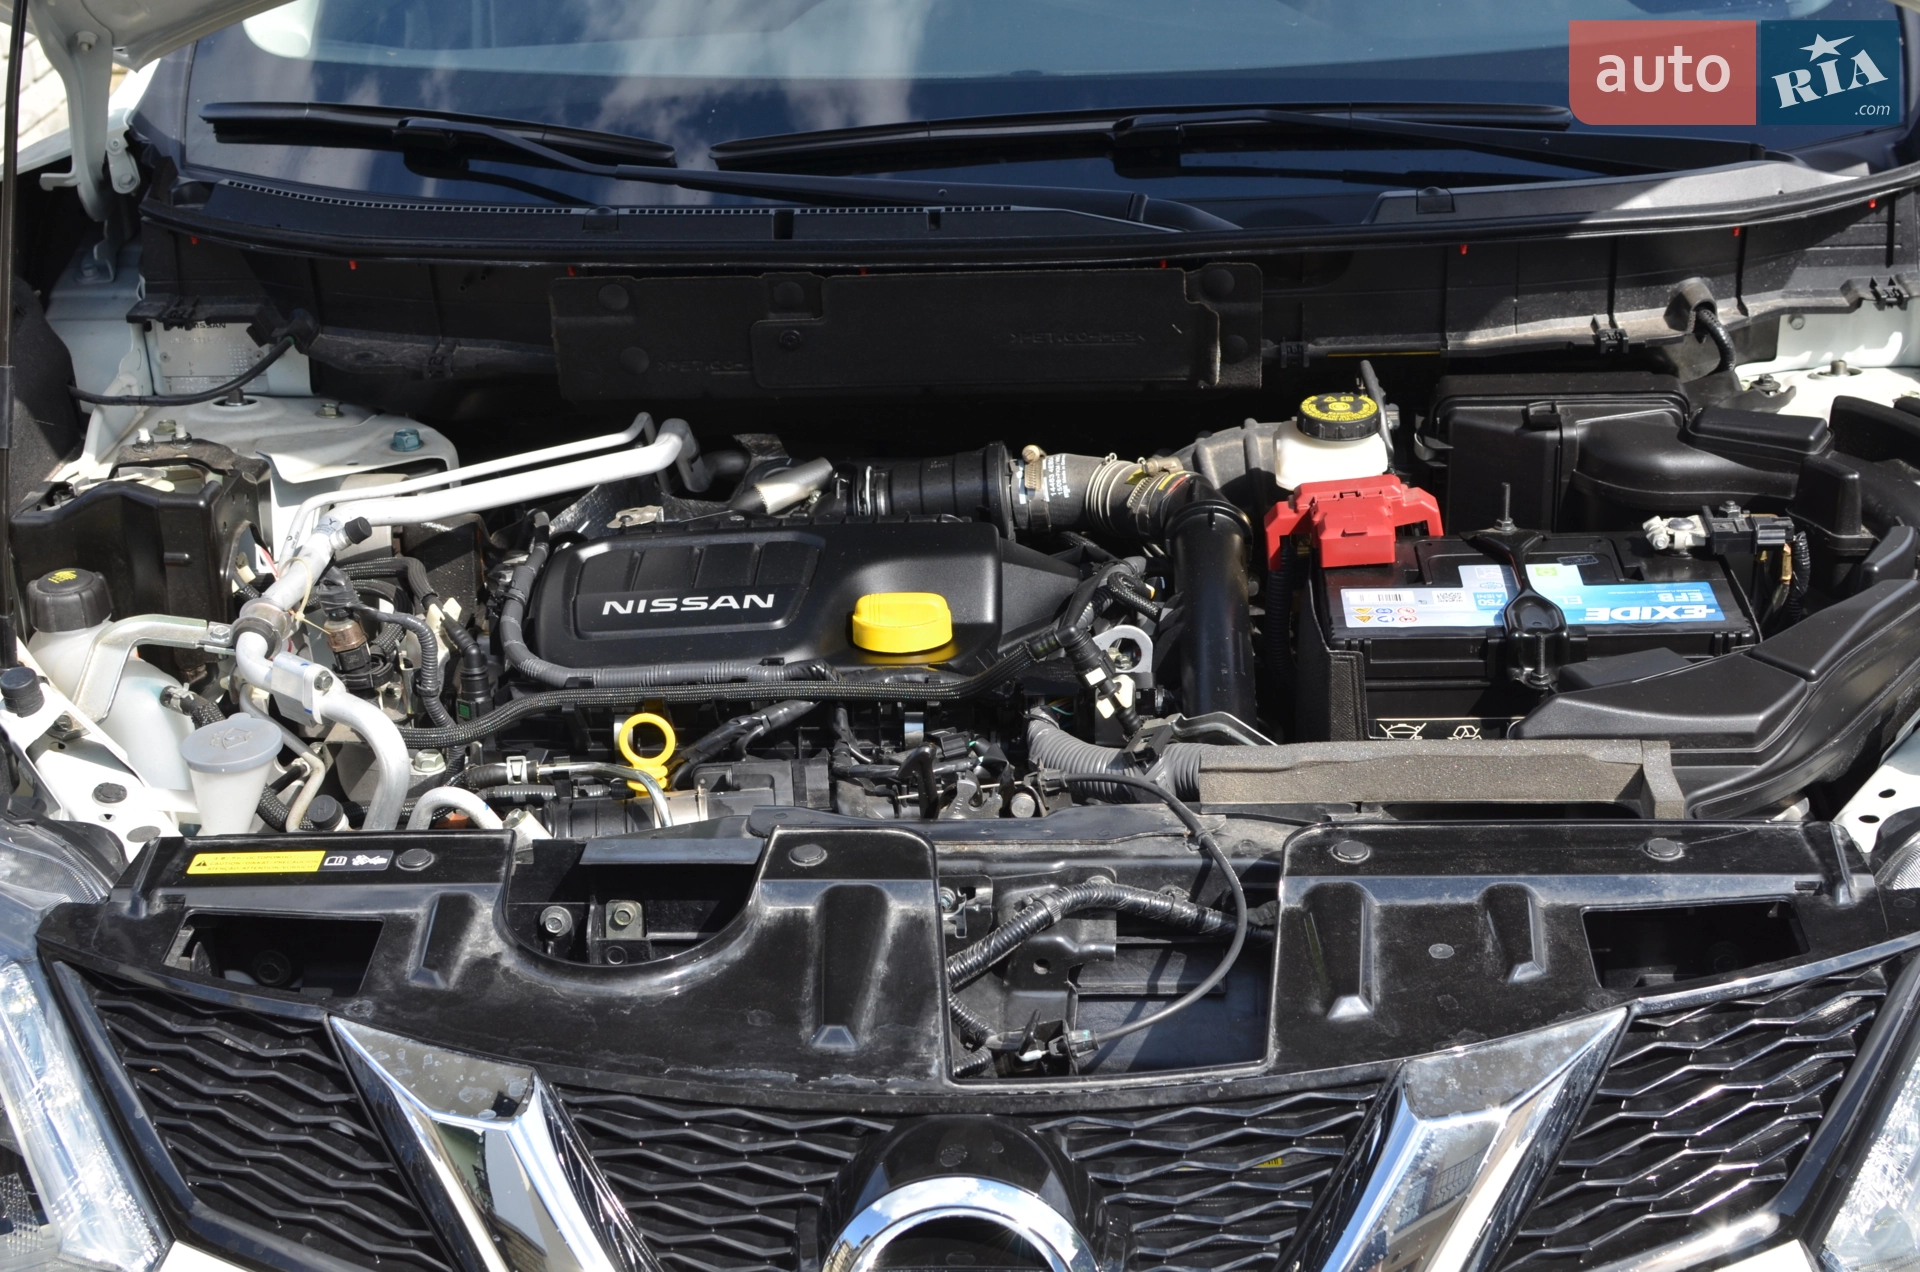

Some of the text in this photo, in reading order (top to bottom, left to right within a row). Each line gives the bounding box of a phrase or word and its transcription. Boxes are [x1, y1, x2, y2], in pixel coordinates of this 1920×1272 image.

[1477, 598, 1505, 606] 750
[1657, 593, 1704, 602] EFB
[602, 593, 775, 615] NISSAN
[1586, 605, 1716, 621] EXIDE
